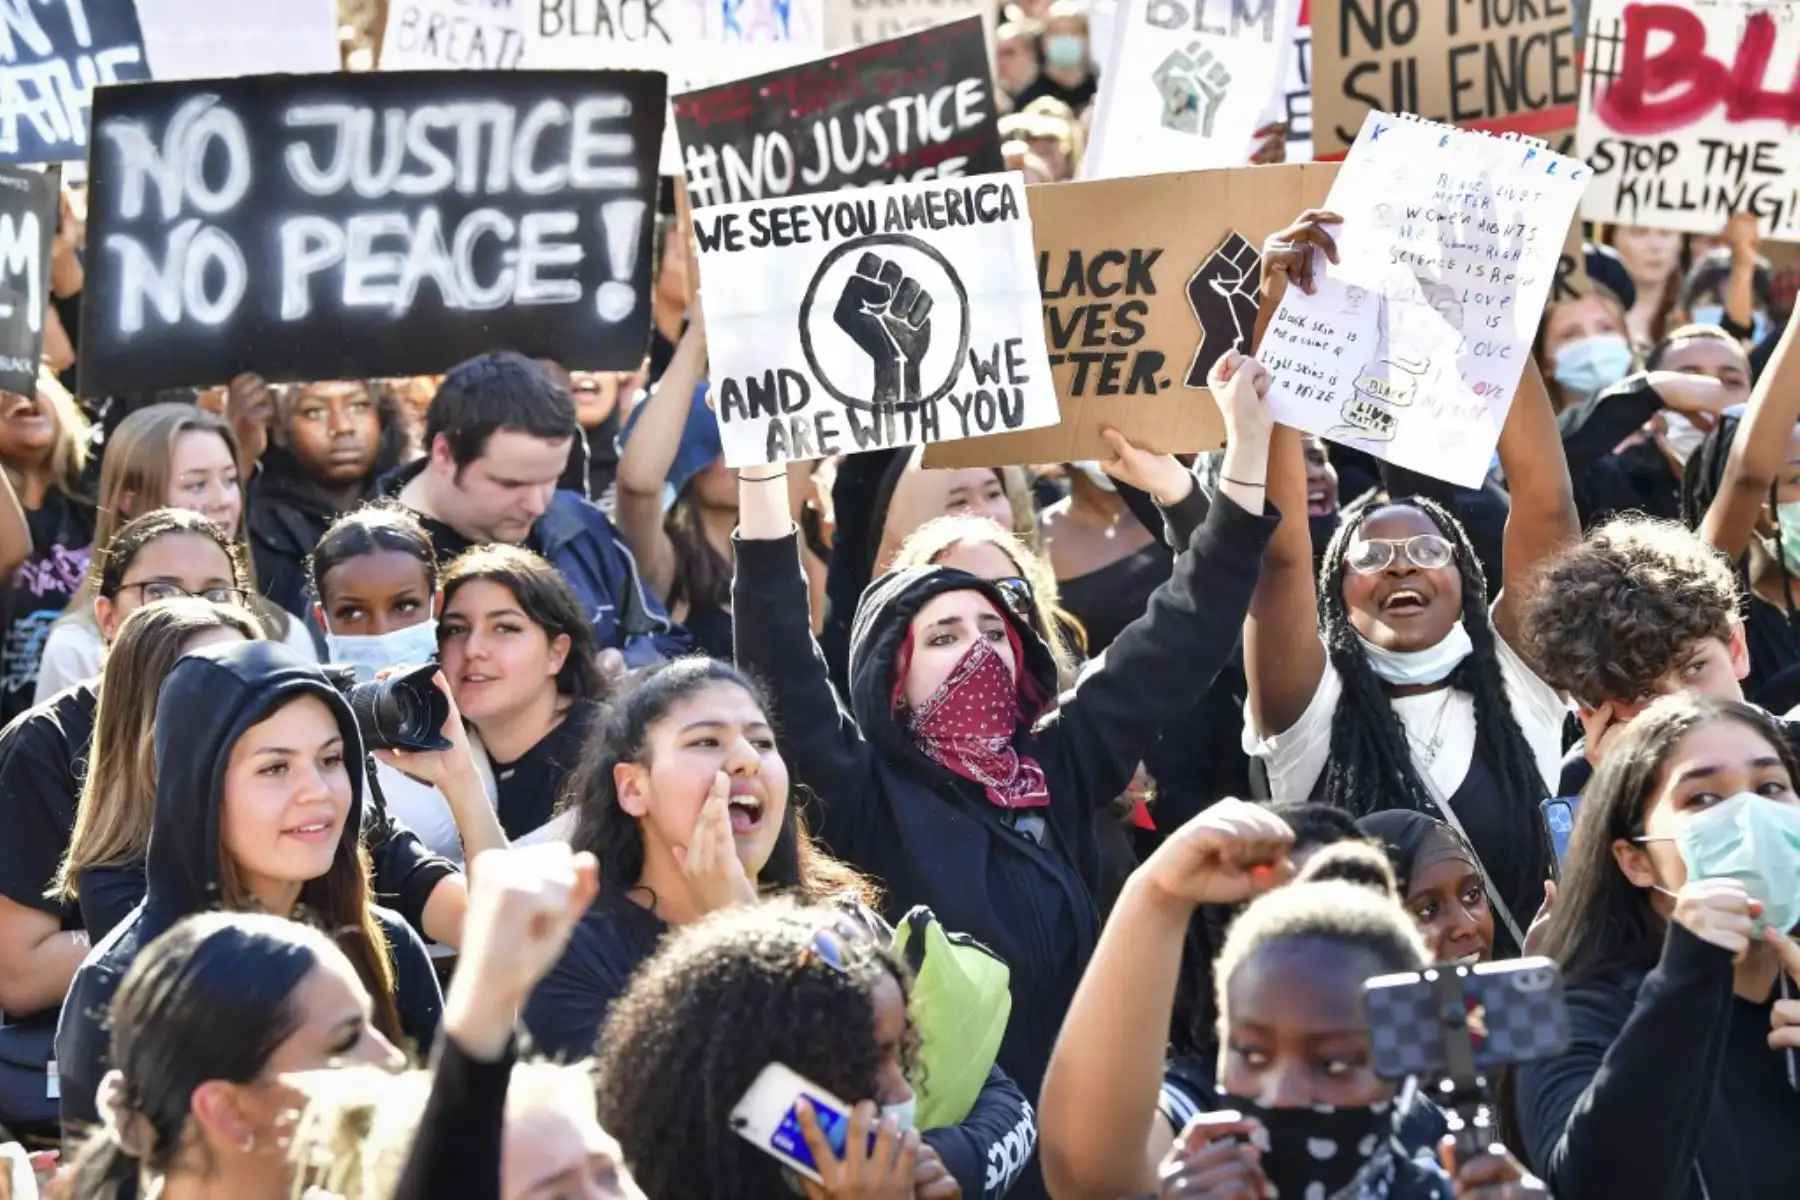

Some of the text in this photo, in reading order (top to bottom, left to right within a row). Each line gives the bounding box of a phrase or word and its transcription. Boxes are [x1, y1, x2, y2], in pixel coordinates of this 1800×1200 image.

[540, 0, 672, 44] BLACK
[1338, 0, 1420, 57] NO
[1585, 2, 1800, 136] #BL
[104, 94, 638, 219] NO JUSTICE
[800, 76, 987, 186] JUSTICE
[1586, 138, 1680, 175] STOP
[1698, 138, 1785, 186] THE
[693, 183, 1019, 253] WE SEE YOU AMERICA
[1615, 178, 1798, 232] KILLING!
[105, 200, 647, 333] NO PEACE!
[1037, 248, 1165, 299] LACK
[1464, 263, 1485, 277] IS
[1043, 299, 1149, 349] VES
[1485, 315, 1502, 329] IS
[720, 336, 1030, 424] AND WE
[765, 387, 1025, 463] ARE WITH YOU
